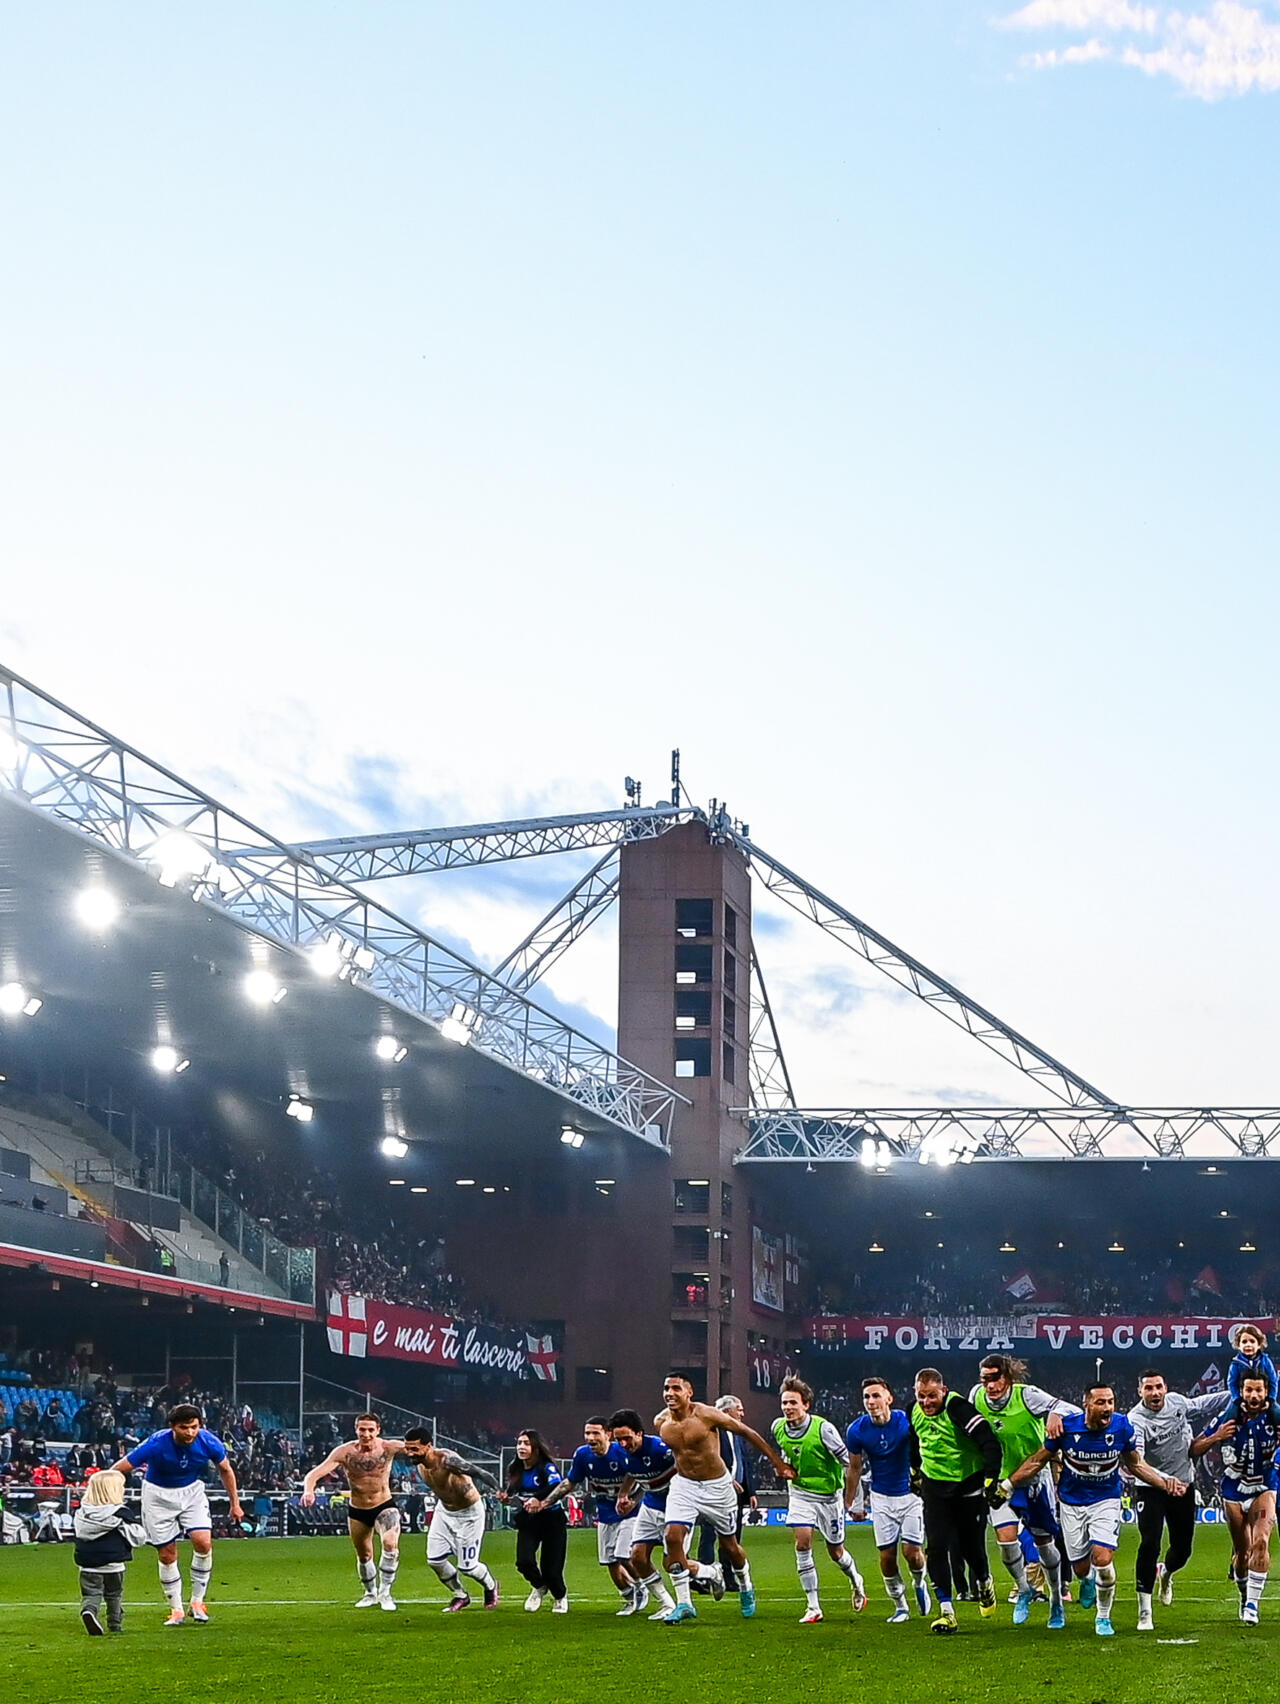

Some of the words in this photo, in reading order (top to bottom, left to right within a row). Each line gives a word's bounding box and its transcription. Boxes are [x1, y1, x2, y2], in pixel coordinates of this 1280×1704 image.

[373, 1319, 389, 1346] e
[394, 1324, 438, 1351] mai
[1078, 1450, 1108, 1459] Banca
[461, 1546, 477, 1560] 10
